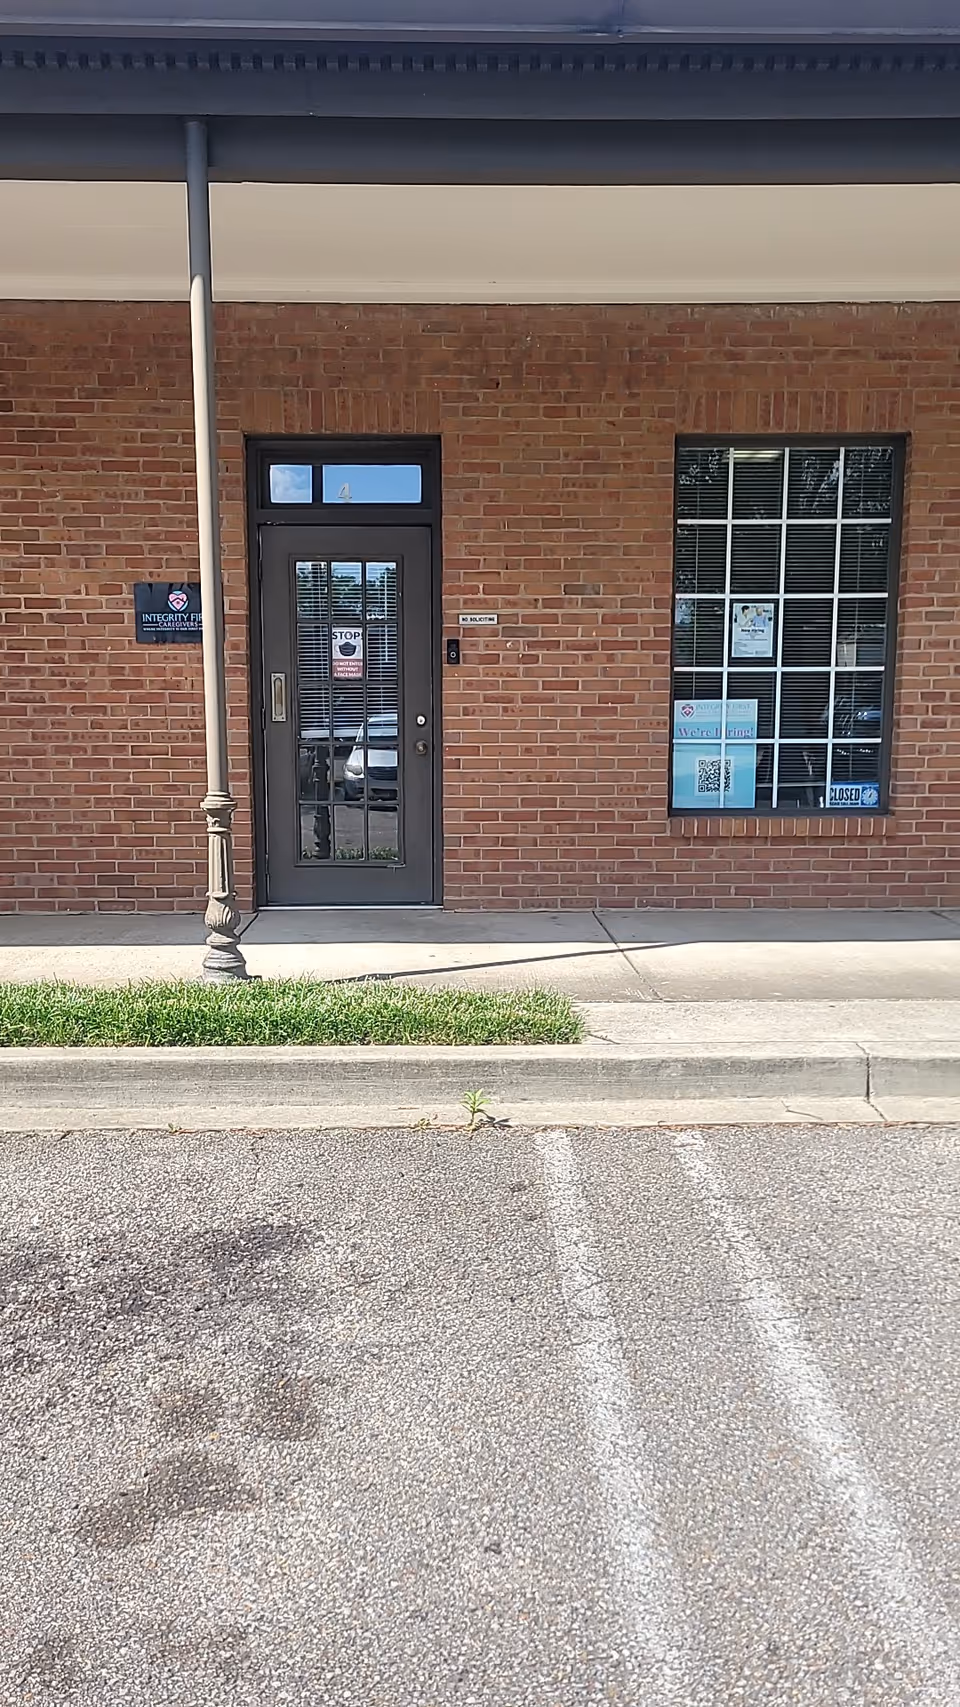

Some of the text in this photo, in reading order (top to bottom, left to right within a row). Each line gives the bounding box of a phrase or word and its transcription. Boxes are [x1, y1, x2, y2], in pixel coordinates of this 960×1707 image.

[142, 613, 189, 622] INTEGRITY
[678, 727, 754, 739] We're Hring!
[830, 787, 860, 801] CLOSED
